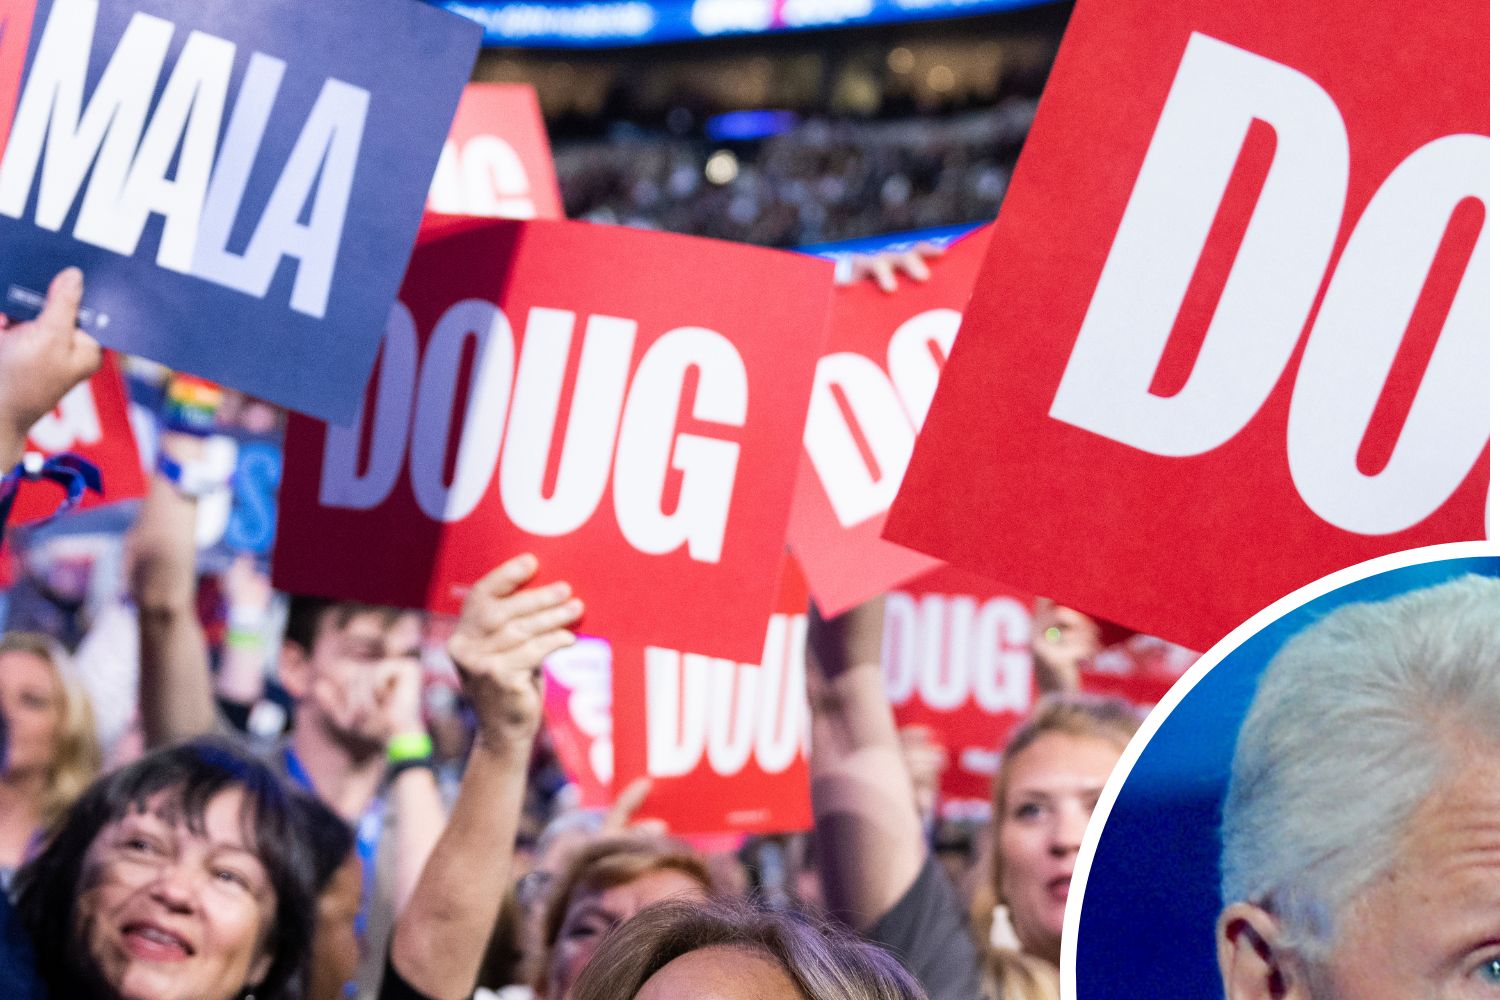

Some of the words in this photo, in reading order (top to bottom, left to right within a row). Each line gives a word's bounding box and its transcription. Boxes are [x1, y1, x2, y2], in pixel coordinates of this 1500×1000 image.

[0, 0, 371, 320] MALA
[320, 298, 748, 564] DOUG
[644, 613, 811, 777] DOU
